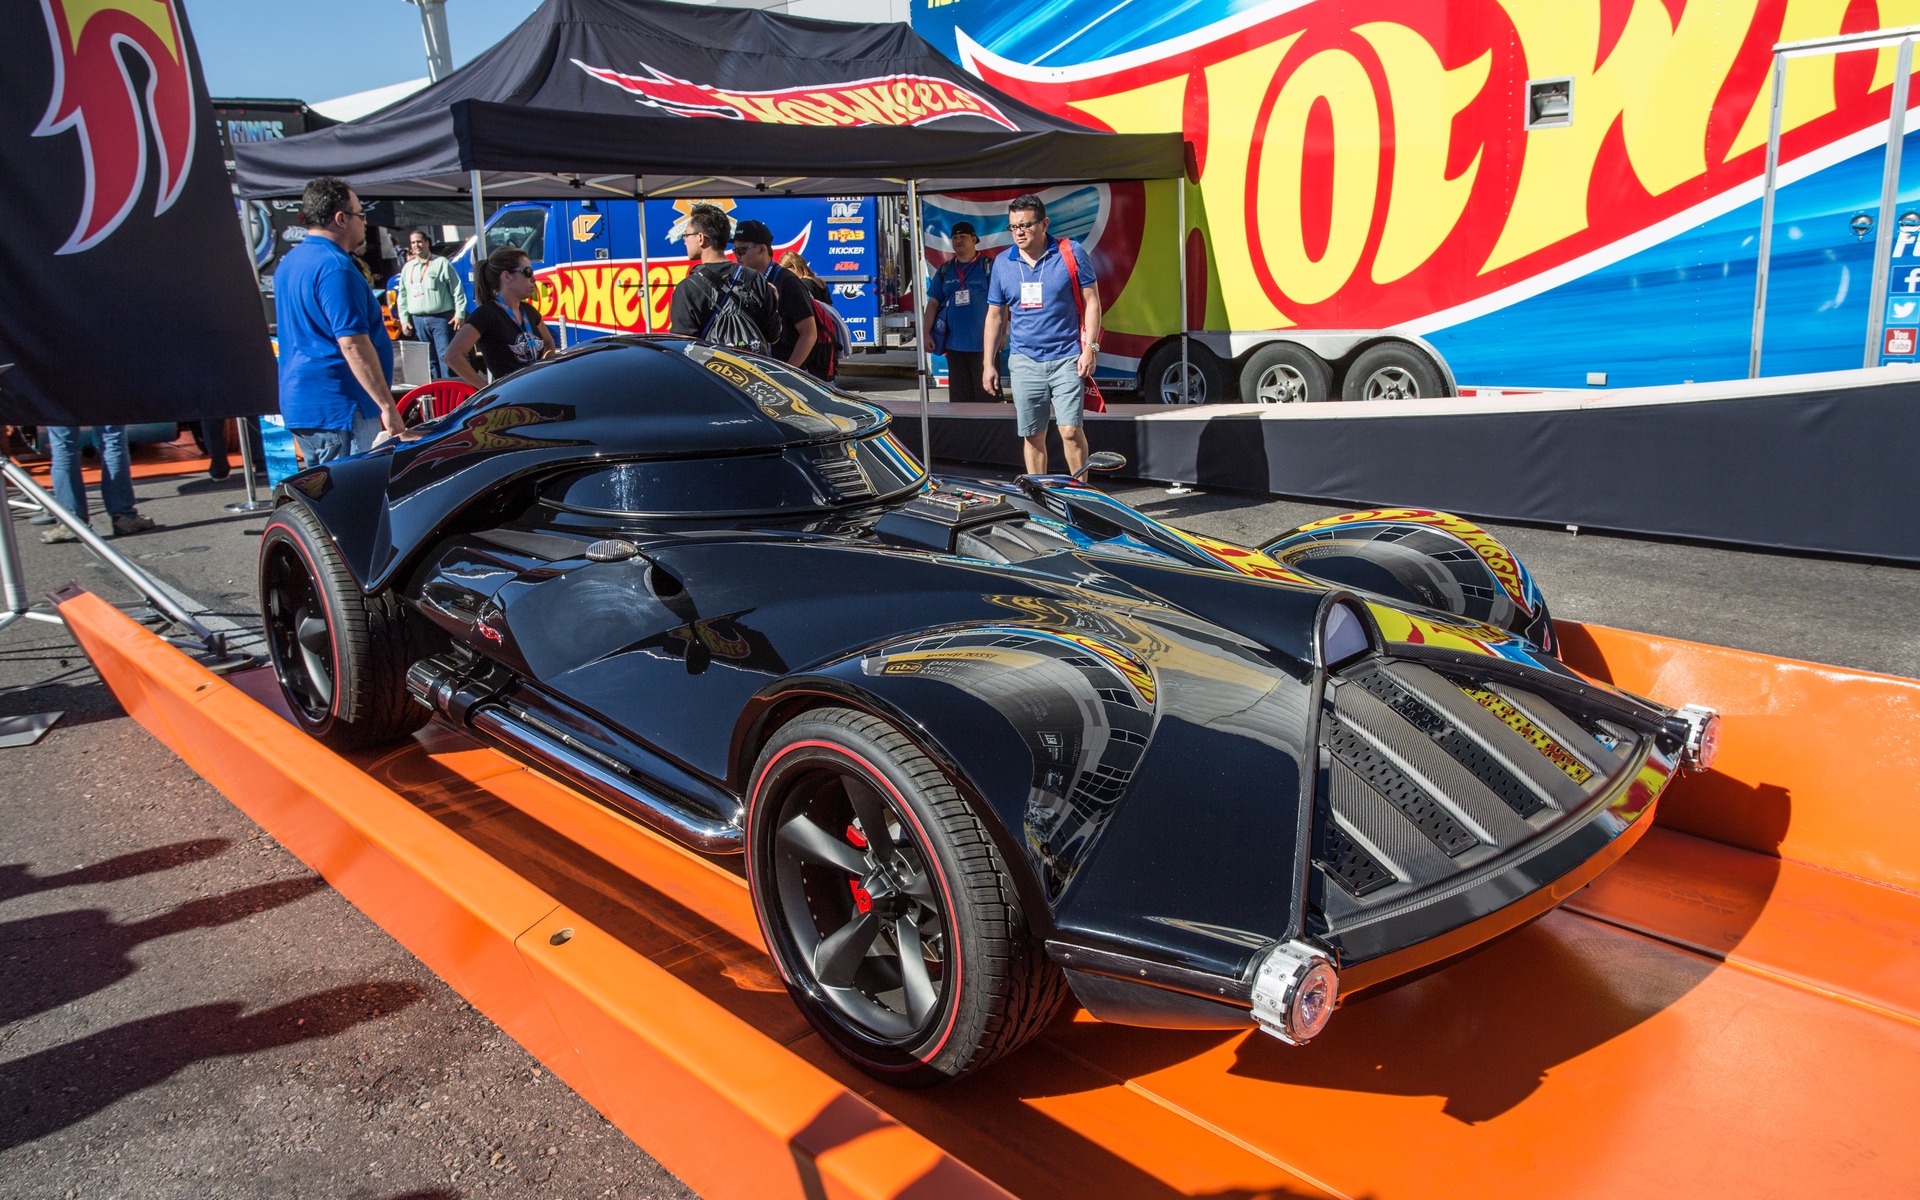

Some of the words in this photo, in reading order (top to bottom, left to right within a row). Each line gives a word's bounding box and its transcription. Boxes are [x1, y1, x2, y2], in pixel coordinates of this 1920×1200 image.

[834, 261, 859, 271] KTM
[832, 283, 864, 299] FOX
[1894, 330, 1909, 340] You
[1889, 340, 1912, 351] Tube
